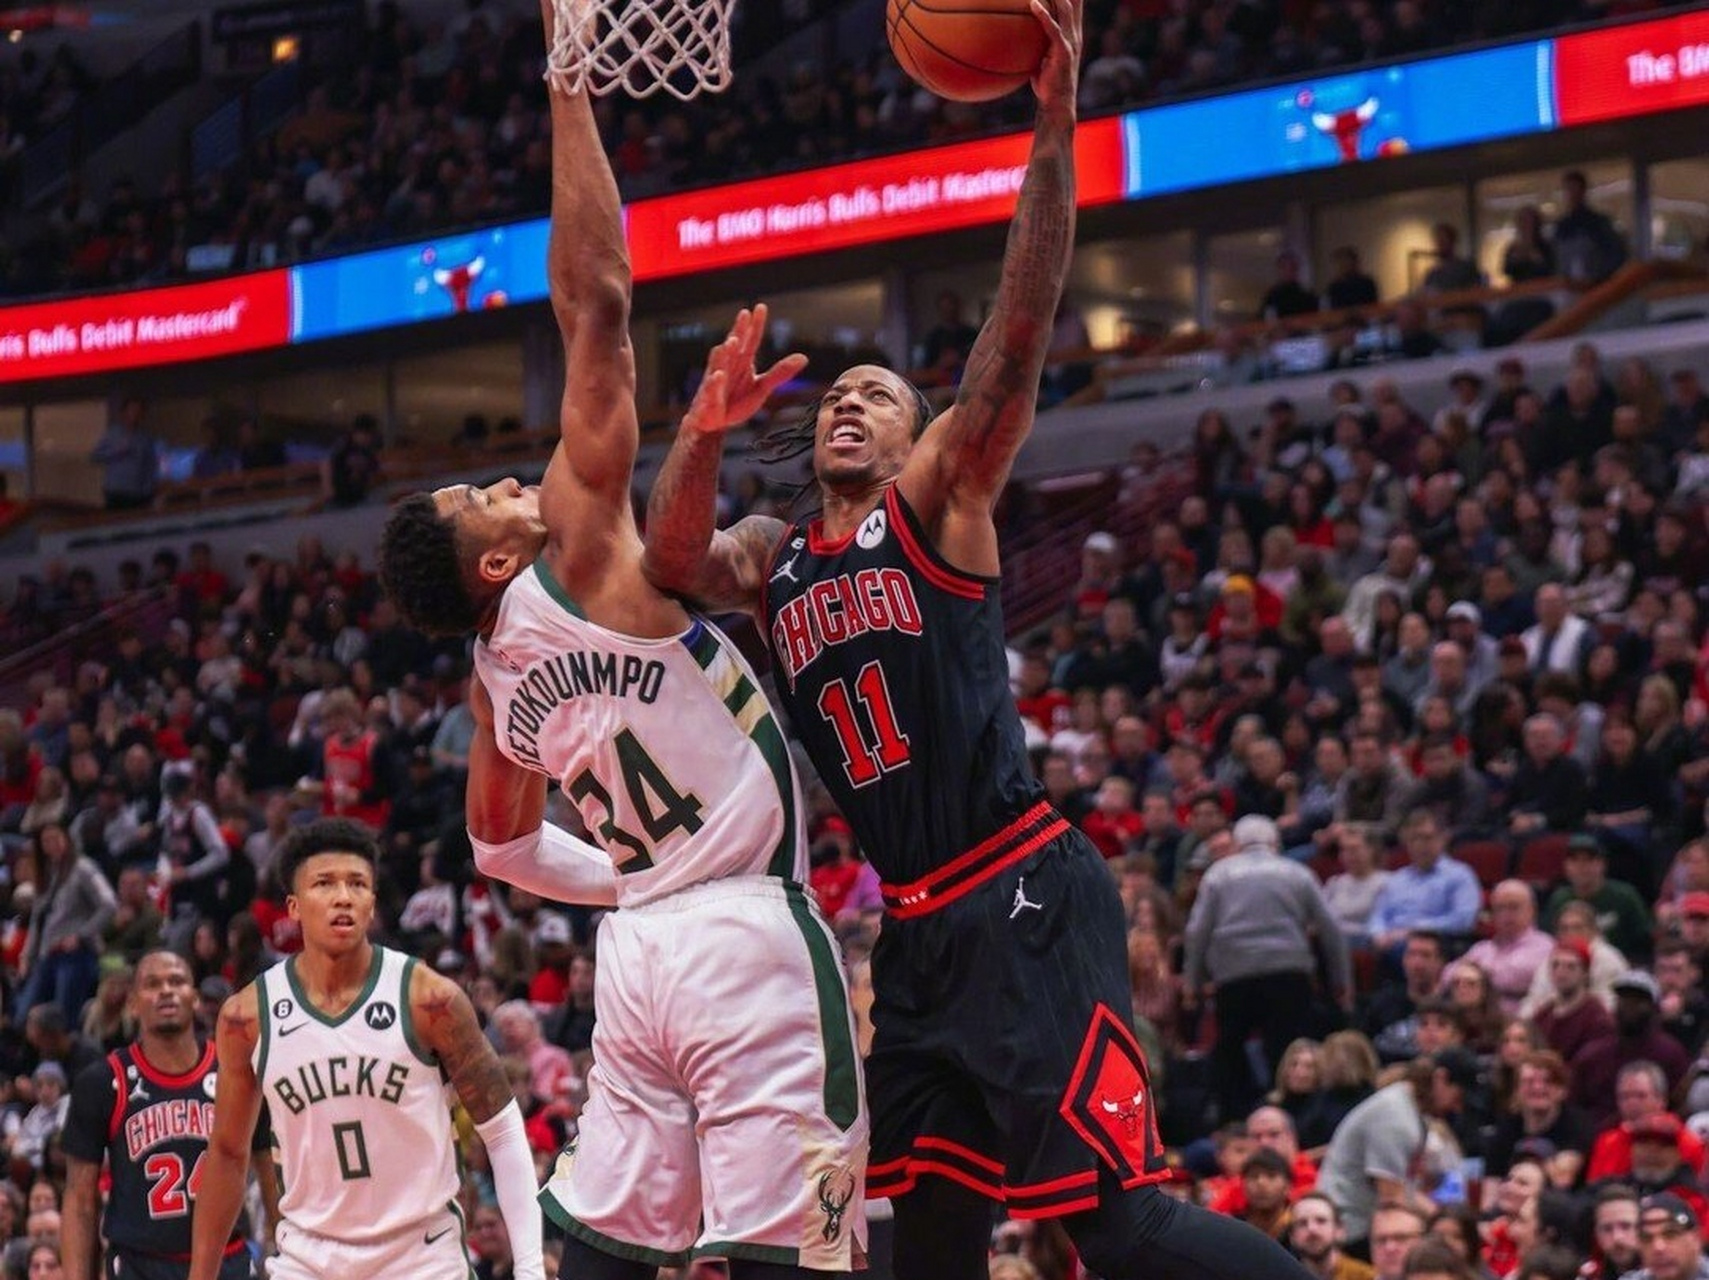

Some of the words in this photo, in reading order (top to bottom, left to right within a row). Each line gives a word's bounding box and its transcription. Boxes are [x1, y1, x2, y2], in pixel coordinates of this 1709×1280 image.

[1627, 50, 1676, 86] The
[677, 216, 715, 249] The
[766, 198, 827, 233] Harris
[828, 186, 880, 223] Bulls
[882, 176, 940, 213] Debit
[28, 324, 77, 358] Bulls
[80, 317, 134, 351] Debit
[817, 659, 911, 789] 11
[568, 727, 704, 875] 34
[273, 1056, 410, 1116] BUCKS
[332, 1120, 371, 1181] 0
